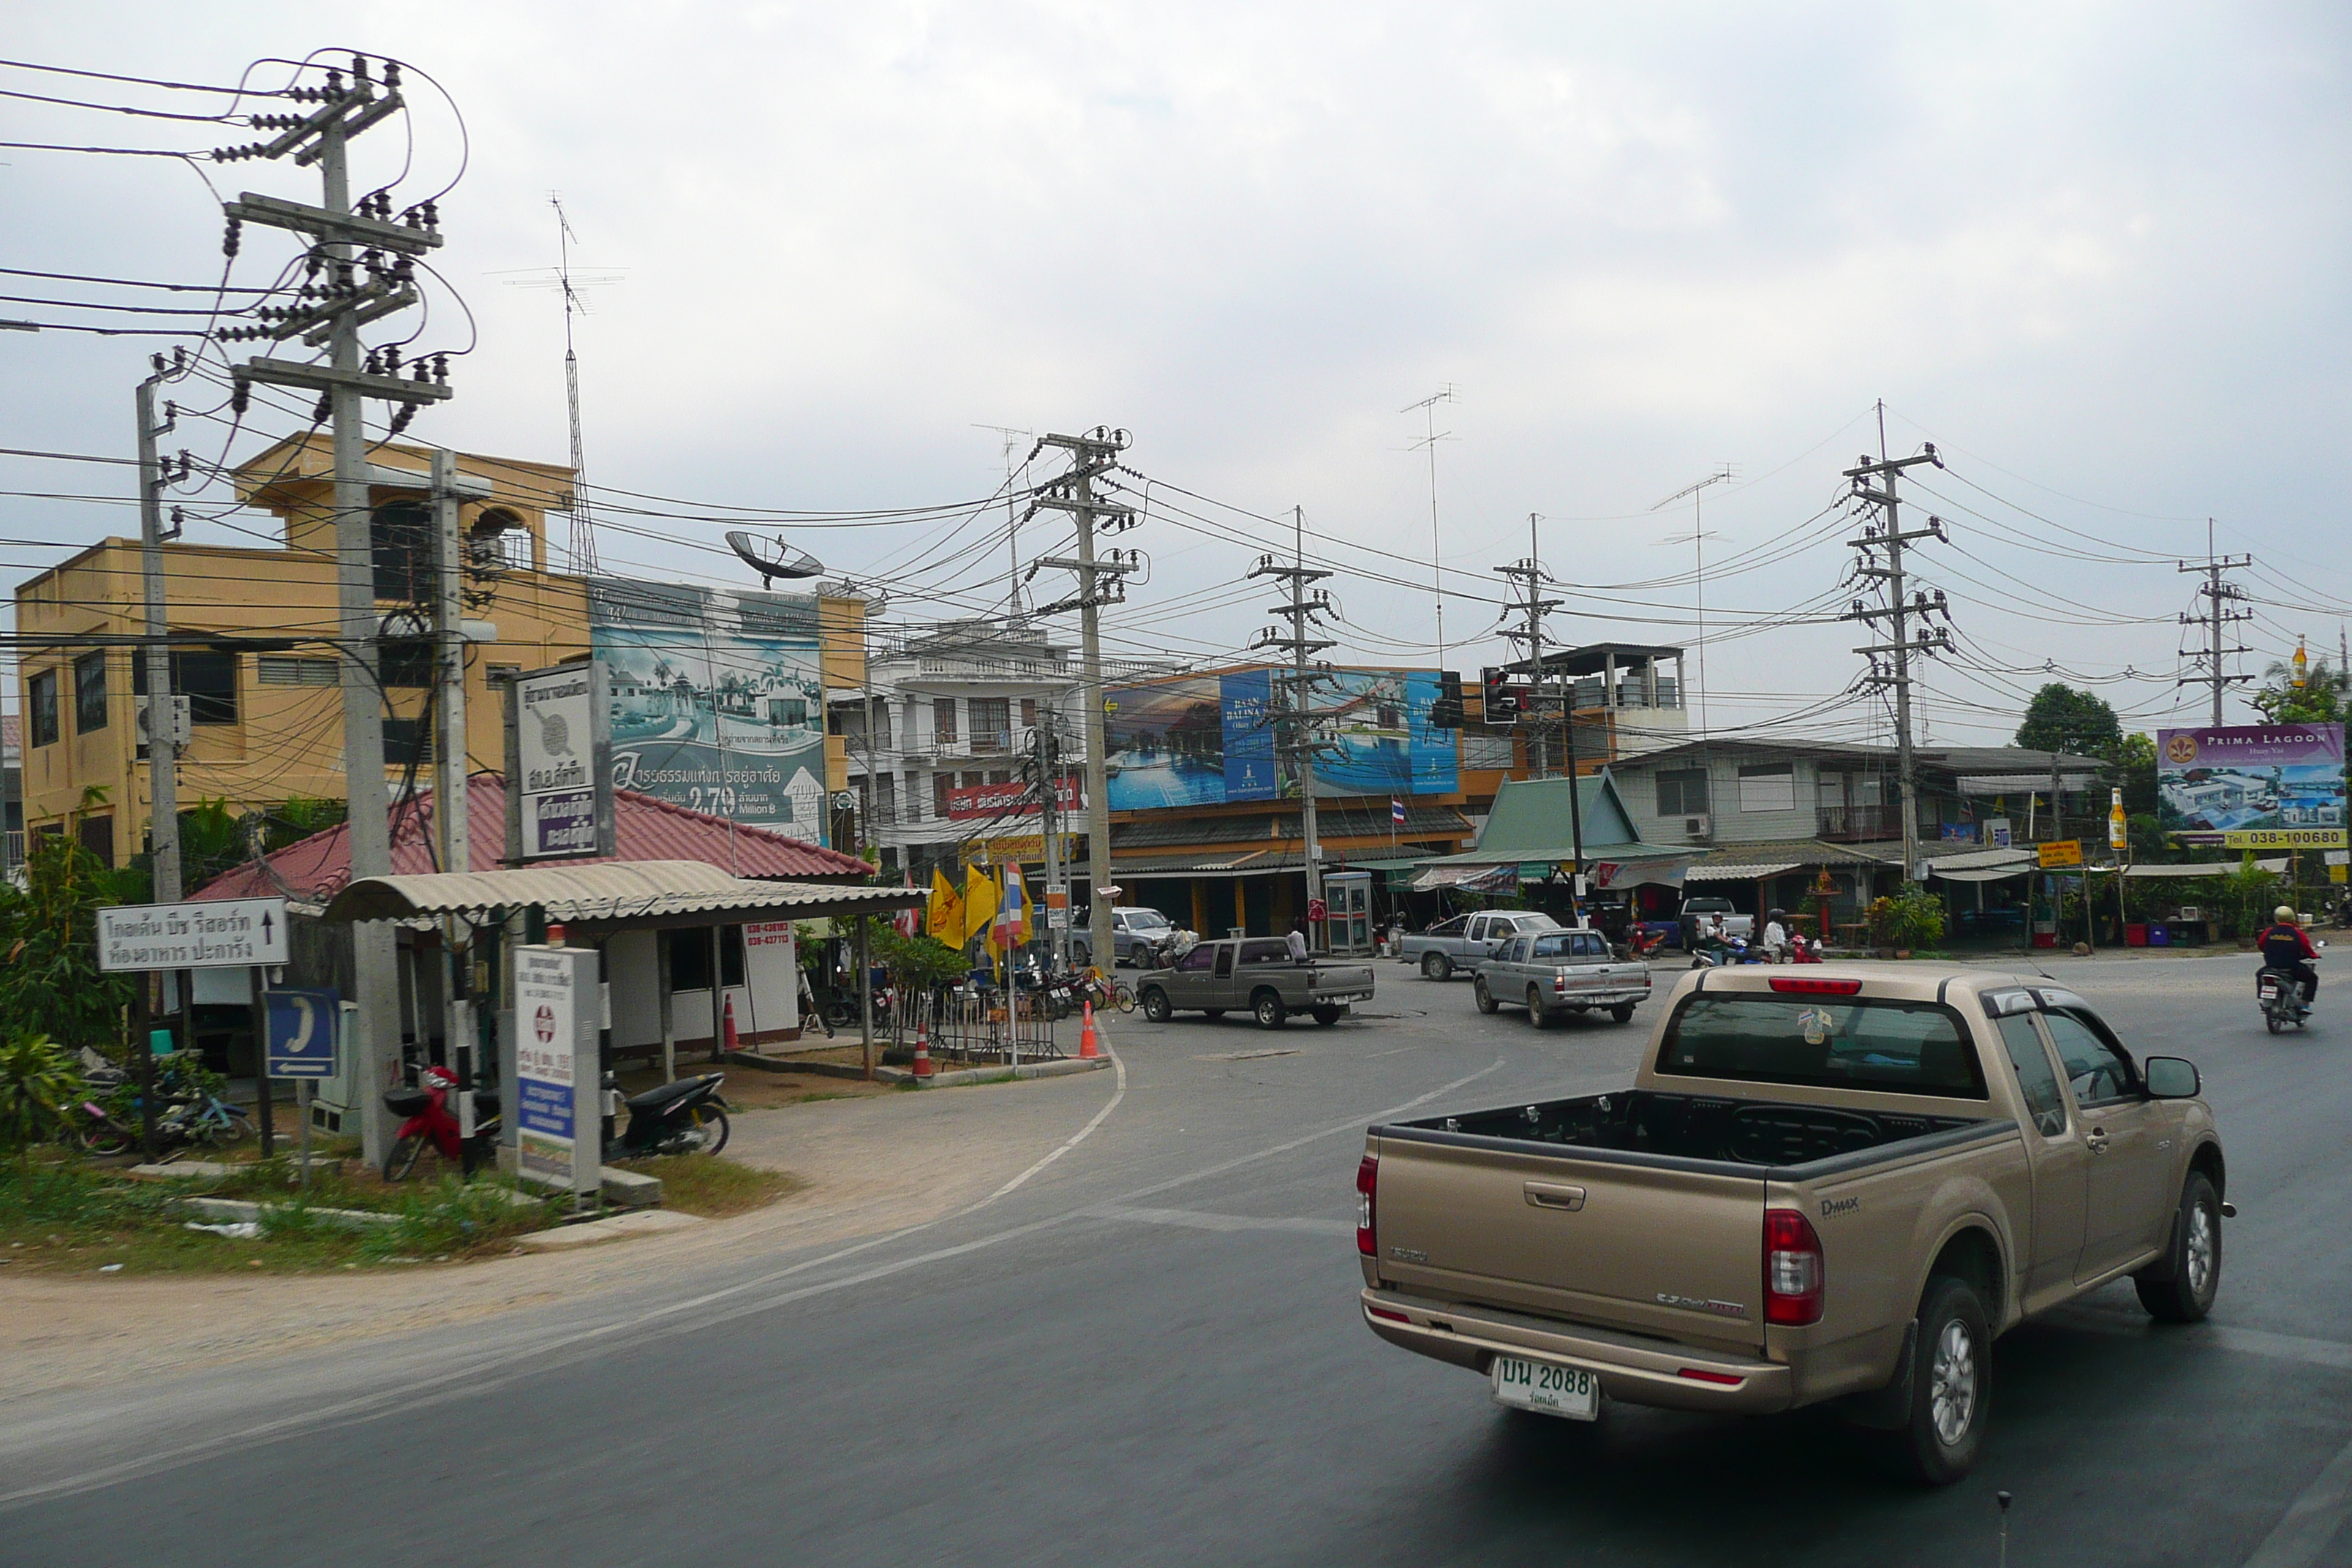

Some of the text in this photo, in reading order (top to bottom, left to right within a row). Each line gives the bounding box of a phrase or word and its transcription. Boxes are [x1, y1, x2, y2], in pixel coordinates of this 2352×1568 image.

[1420, 697, 1436, 706] BAA
[2206, 734, 2326, 746] PRIMA LAGOON
[2250, 832, 2340, 843] 038-100680
[1502, 1359, 1590, 1395] บน 2088
